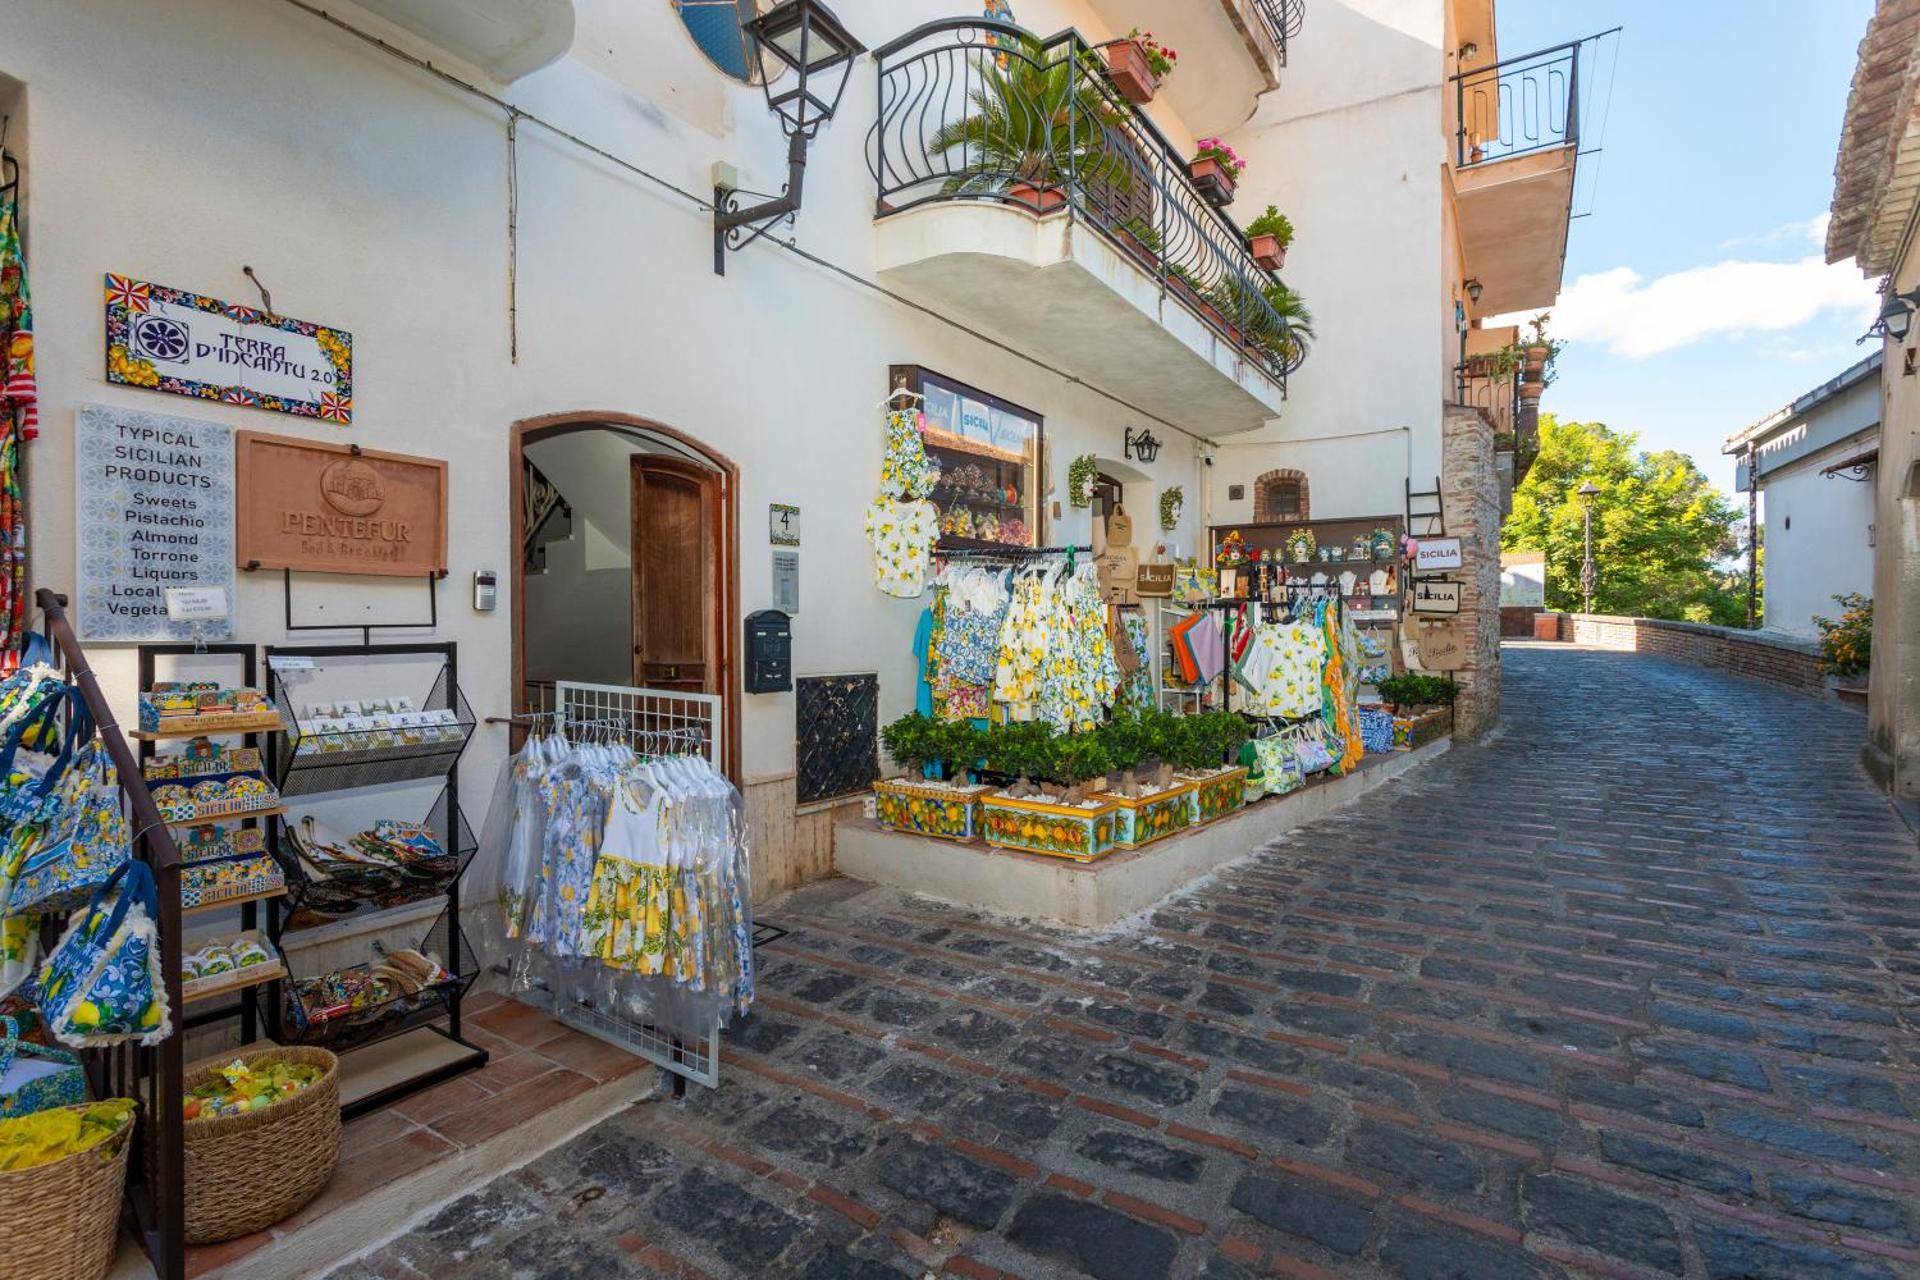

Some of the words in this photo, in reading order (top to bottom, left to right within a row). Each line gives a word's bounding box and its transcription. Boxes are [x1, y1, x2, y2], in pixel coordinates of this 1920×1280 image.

[219, 333, 286, 361] TERRA
[311, 369, 333, 384] 2.0
[115, 424, 200, 449] TYPICAL
[115, 446, 201, 468] SICILIAN
[105, 465, 211, 489] PRODUCTS
[133, 492, 197, 510] Sweets
[125, 510, 205, 528] Pistachio
[281, 511, 412, 544] PENTEFUR
[780, 511, 789, 530] 4
[131, 529, 198, 545] Almond
[130, 547, 199, 562] Torrone
[1419, 548, 1458, 559] SICILIA
[132, 567, 199, 581] Liquors
[1140, 573, 1172, 583] SCILIA
[112, 584, 161, 597] Local
[1417, 592, 1455, 601] SCILIA
